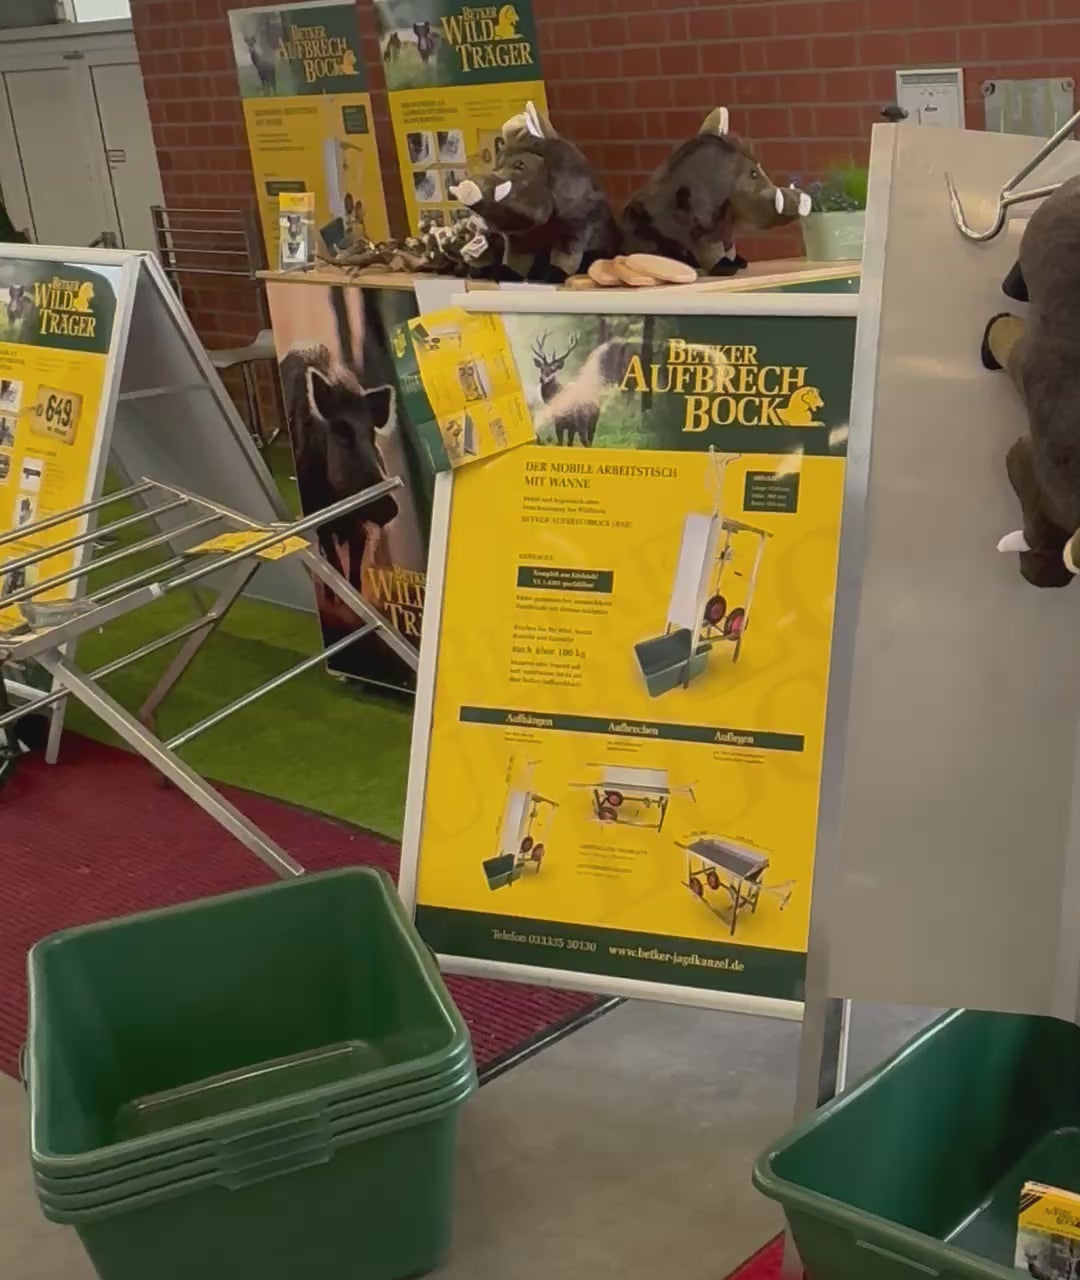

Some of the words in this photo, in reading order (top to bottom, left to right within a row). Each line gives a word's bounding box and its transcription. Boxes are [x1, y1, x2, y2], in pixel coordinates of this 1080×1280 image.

[440, 16, 495, 45] WILD
[34, 282, 73, 311] WILD
[667, 338, 758, 365] BETKER
[619, 355, 808, 395] AUFBRECH
[682, 395, 785, 432] BOCK
[524, 476, 546, 487] MIT
[549, 477, 591, 489] WANNE
[525, 461, 548, 473] DER
[551, 462, 594, 475] MOBILE
[491, 929, 527, 944] Telefon
[609, 944, 745, 971] www.betker-jagdkanzel.de
